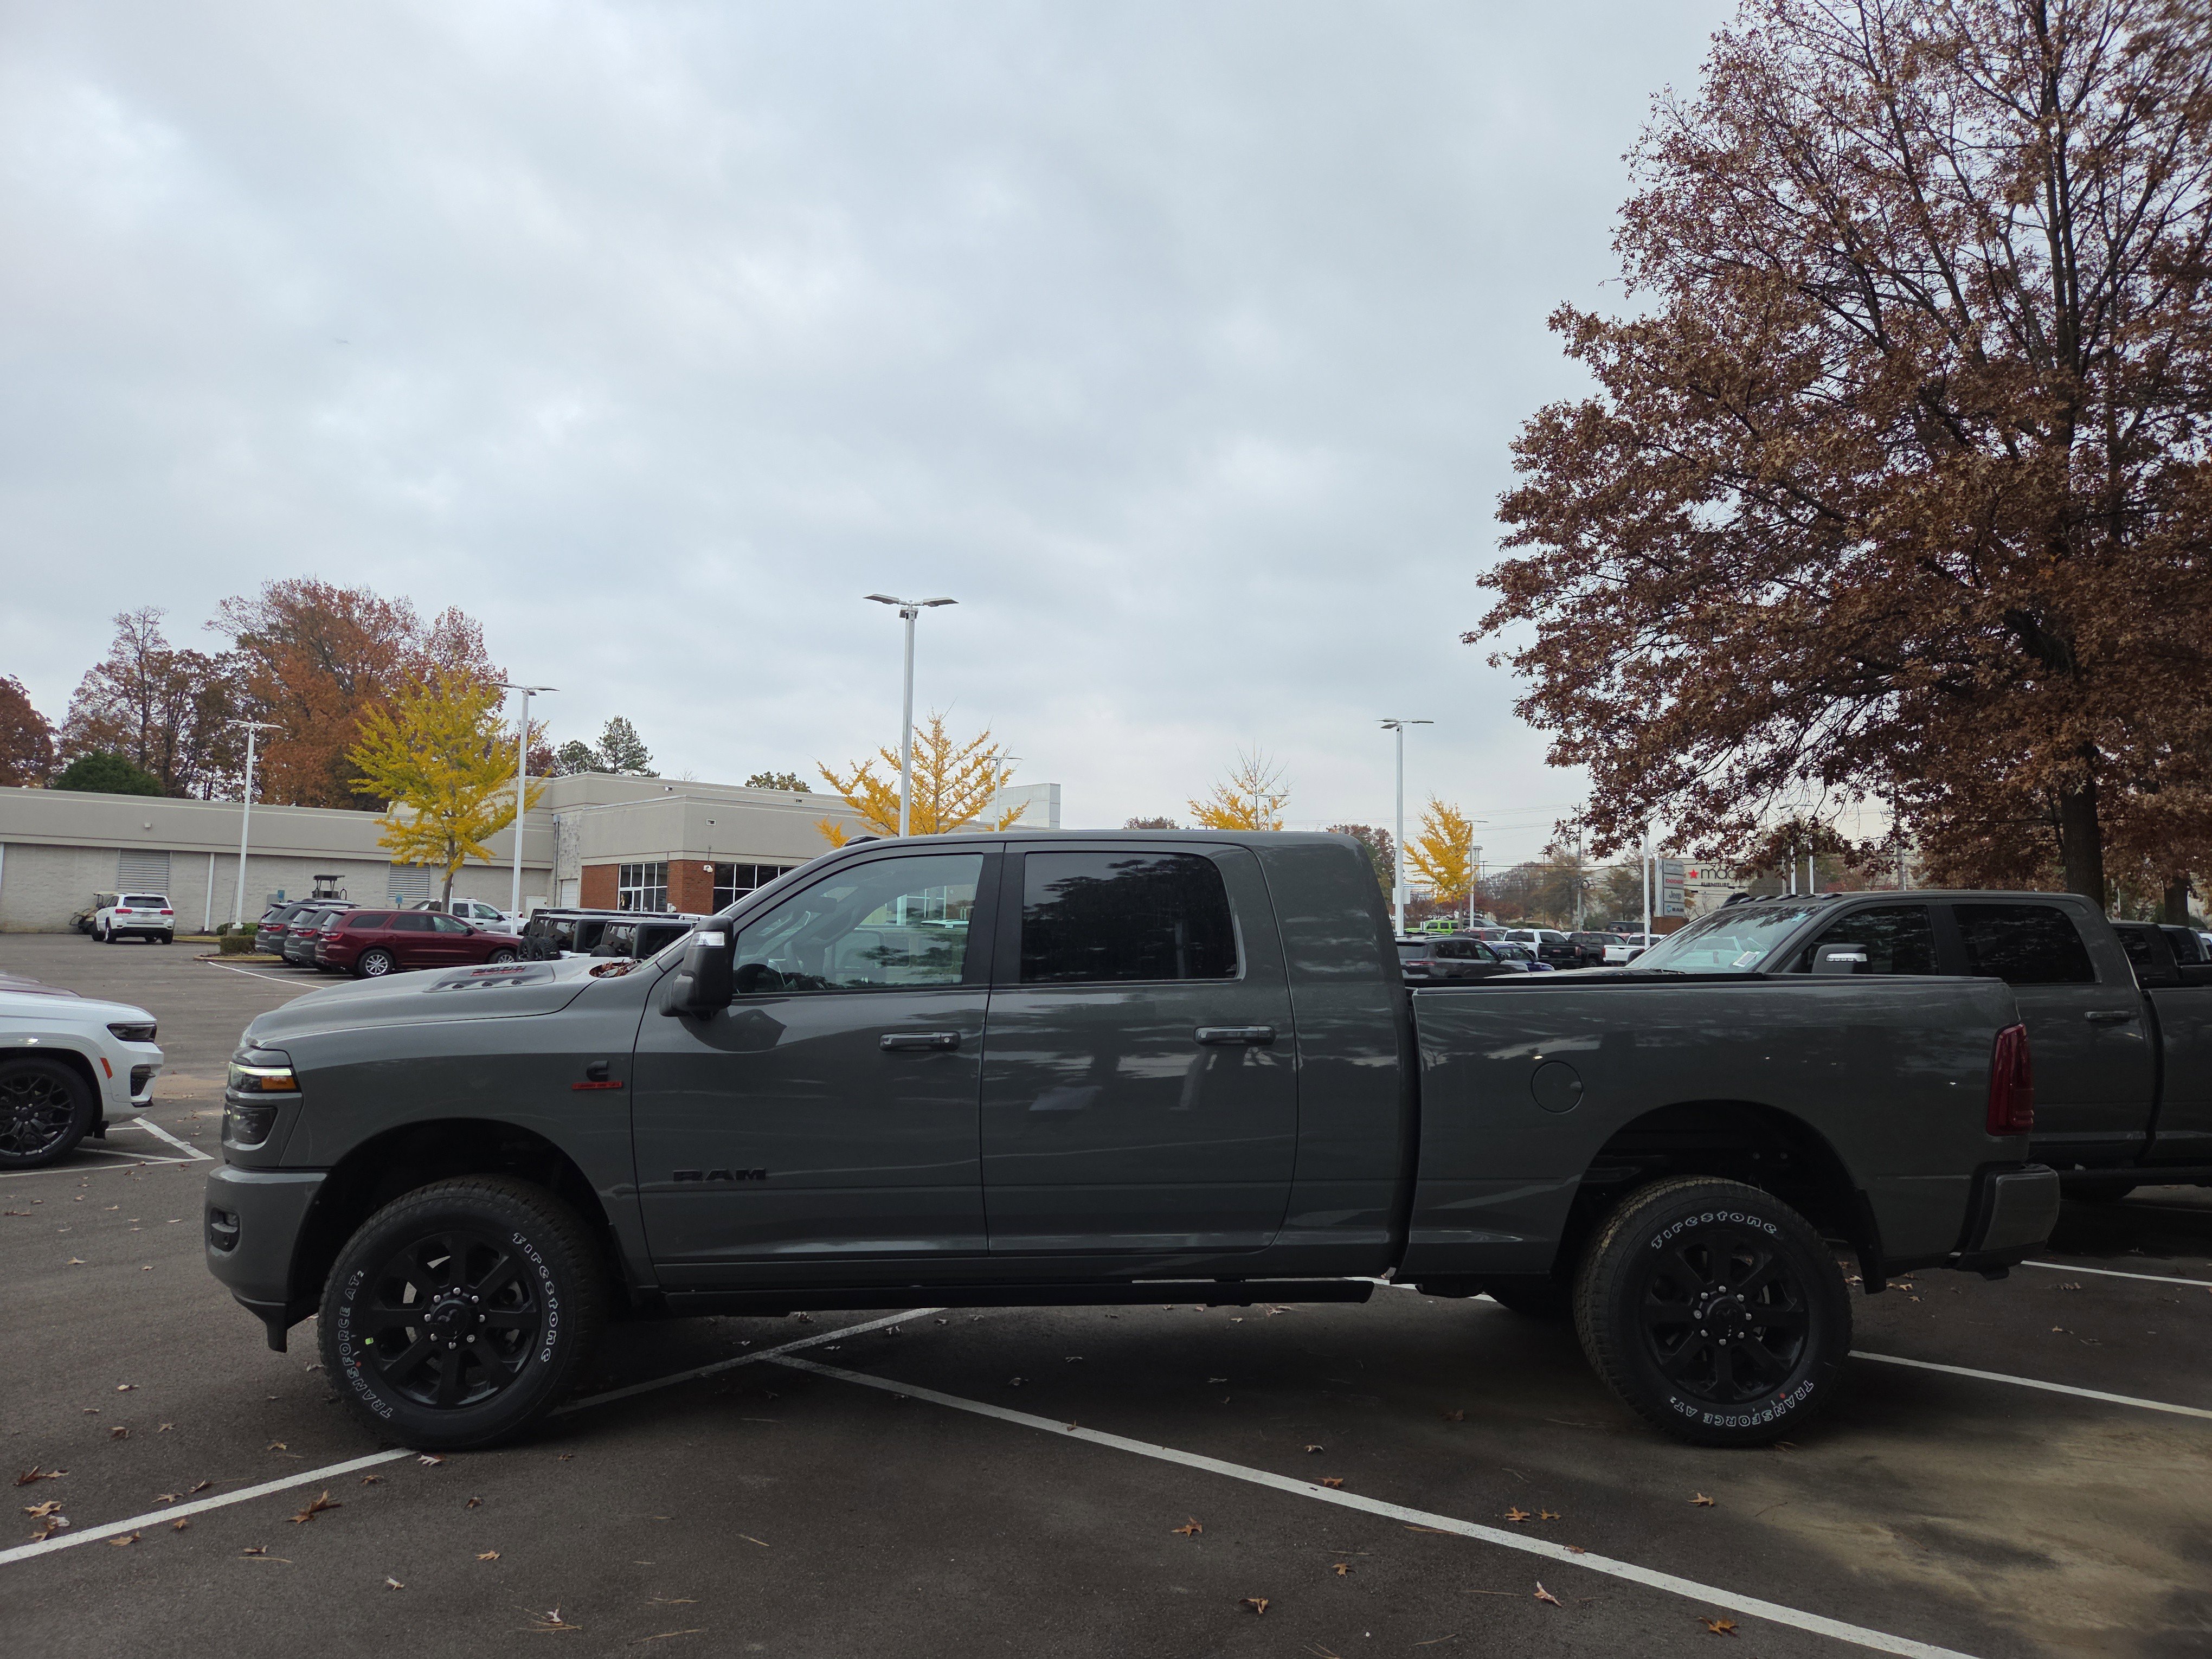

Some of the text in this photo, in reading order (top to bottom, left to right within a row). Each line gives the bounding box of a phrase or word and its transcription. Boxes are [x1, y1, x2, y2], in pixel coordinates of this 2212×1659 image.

[1669, 891, 1682, 901] Jeep
[673, 1168, 766, 1181] RAM
[1651, 1211, 1777, 1249] Firestone
[513, 1232, 558, 1362] Firestone
[338, 1307, 393, 1418] TRANSFORCE
[1703, 1380, 1814, 1427] TRANSFORCE
